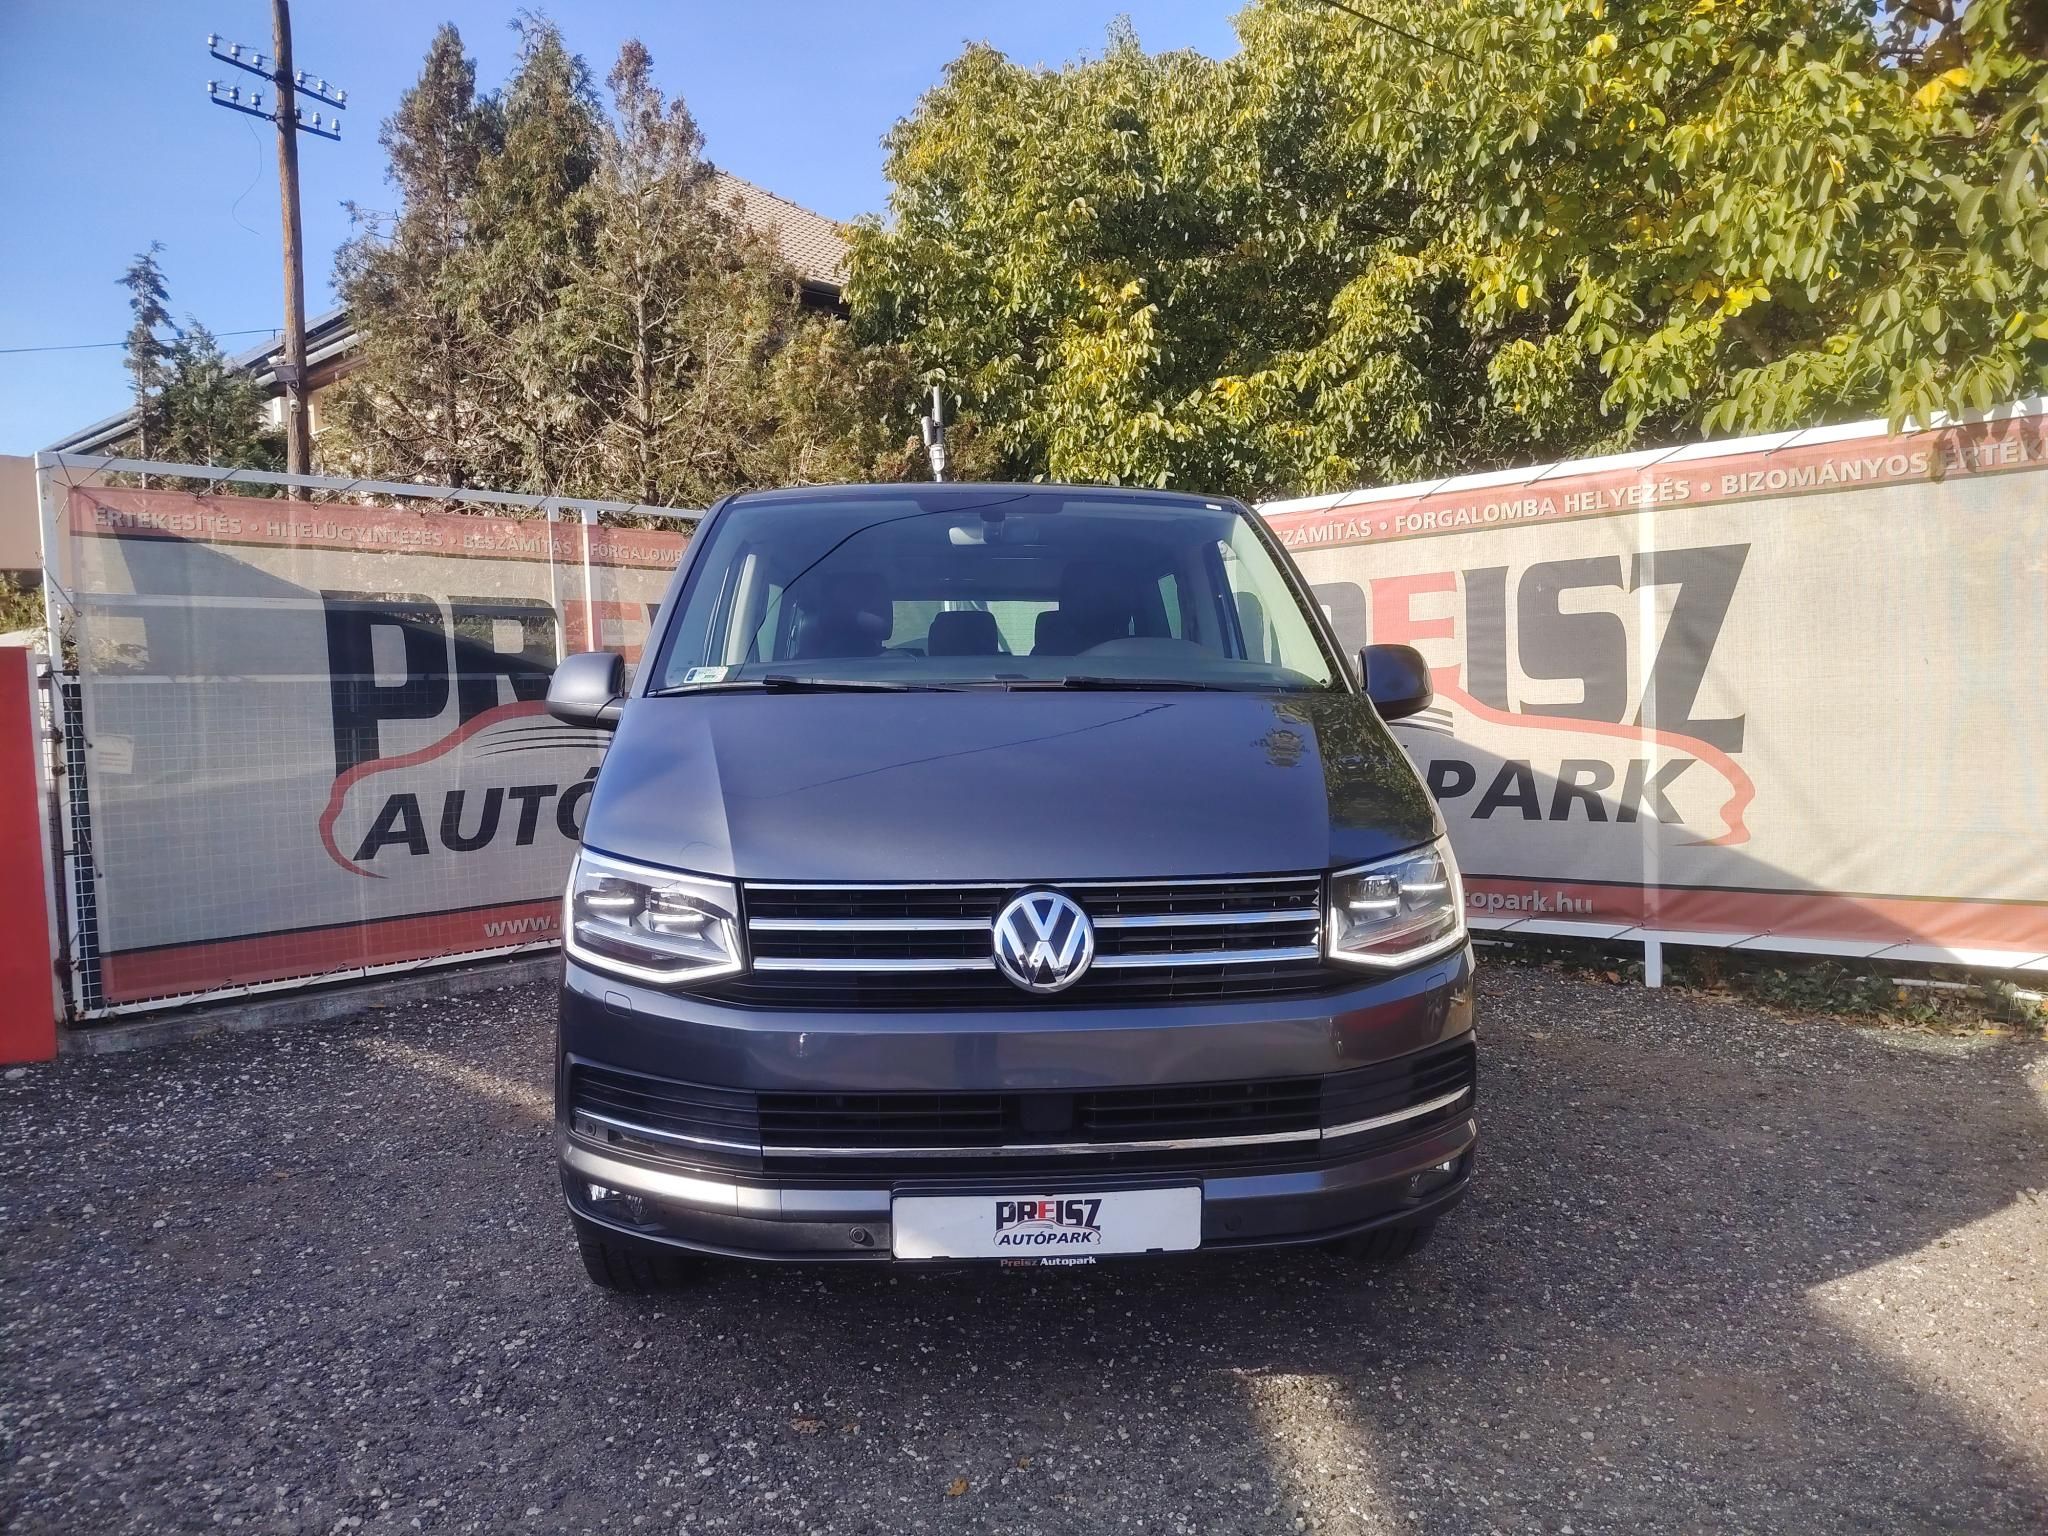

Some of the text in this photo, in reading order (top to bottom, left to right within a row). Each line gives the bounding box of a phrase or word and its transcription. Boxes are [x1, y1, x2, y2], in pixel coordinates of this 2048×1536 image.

[1395, 497, 1558, 532] FORGALOMBA
[1564, 477, 1691, 513] HELYEZÉS
[1721, 451, 1929, 495] BIZOMÁNYOS
[1939, 436, 2048, 472] ÉRTÉK
[95, 506, 243, 536] ÉRTÉKESÍTÉS
[463, 532, 573, 555] BESZÁMÍTÁS
[320, 589, 661, 778] PRE
[995, 1199, 1103, 1232] PREISZ
[998, 1230, 1094, 1247] AUTÓPARK
[1000, 1256, 1097, 1268] Preisz Autopark
